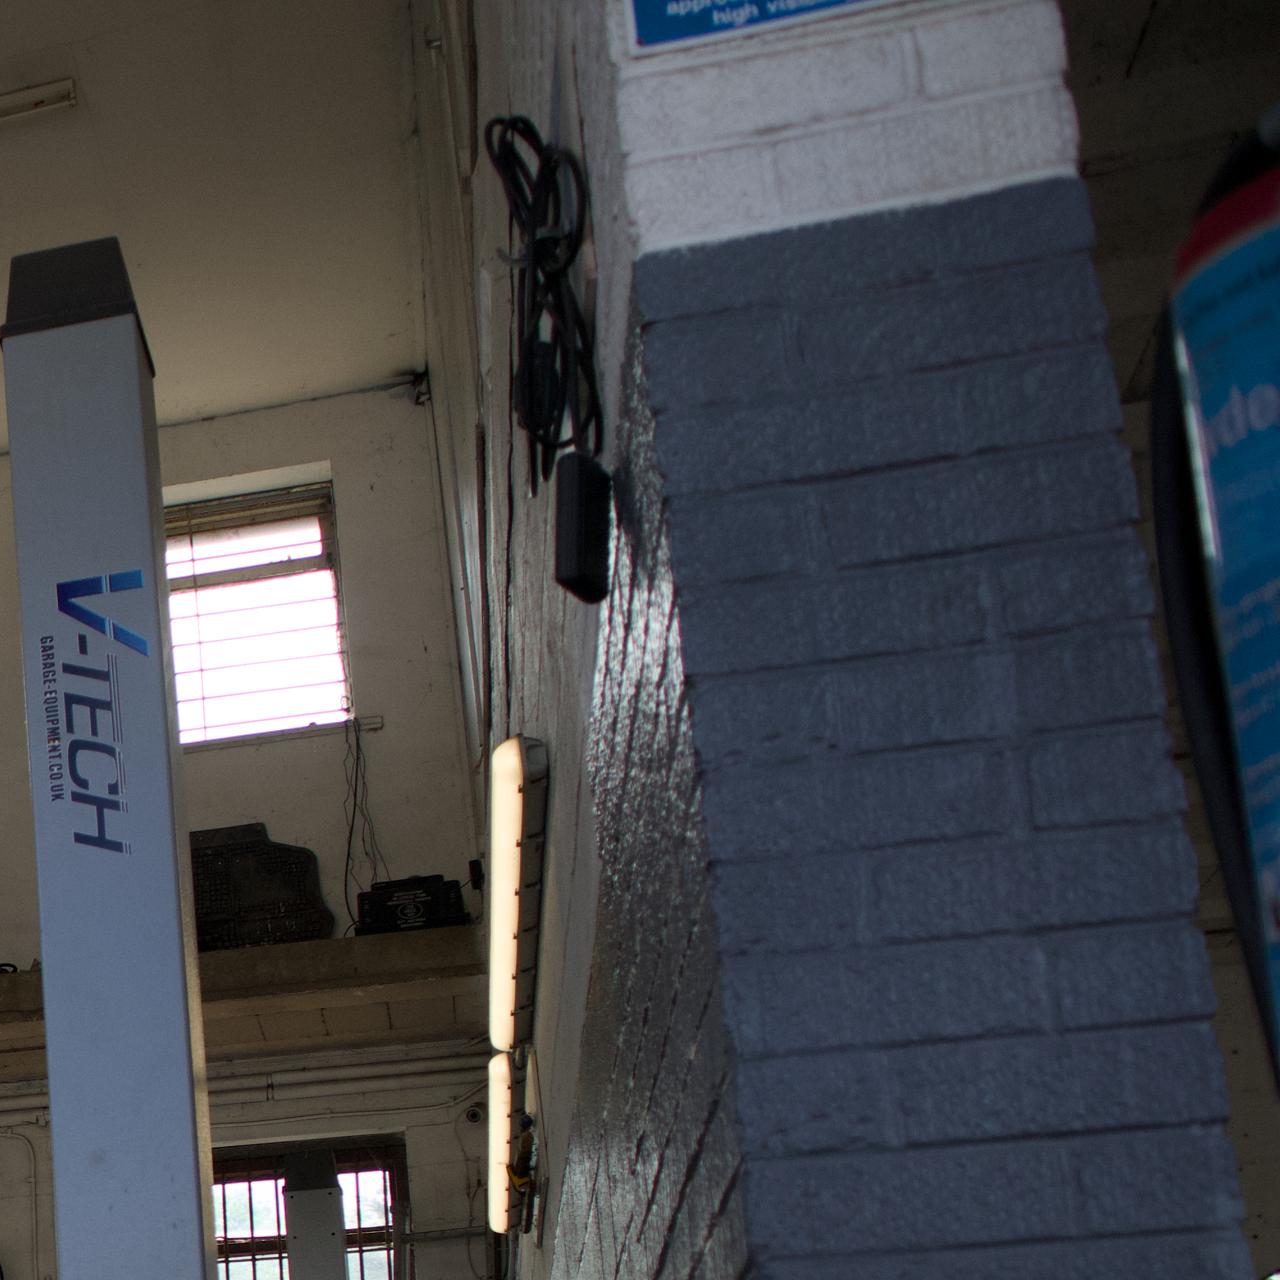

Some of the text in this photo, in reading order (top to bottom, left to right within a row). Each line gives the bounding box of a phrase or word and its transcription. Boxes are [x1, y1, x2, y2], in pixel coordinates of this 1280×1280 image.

[712, 4, 760, 26] high
[40, 635, 66, 802] GARAGE-EQUIPMENT.CO.UK
[56, 569, 149, 855] V-TECH
